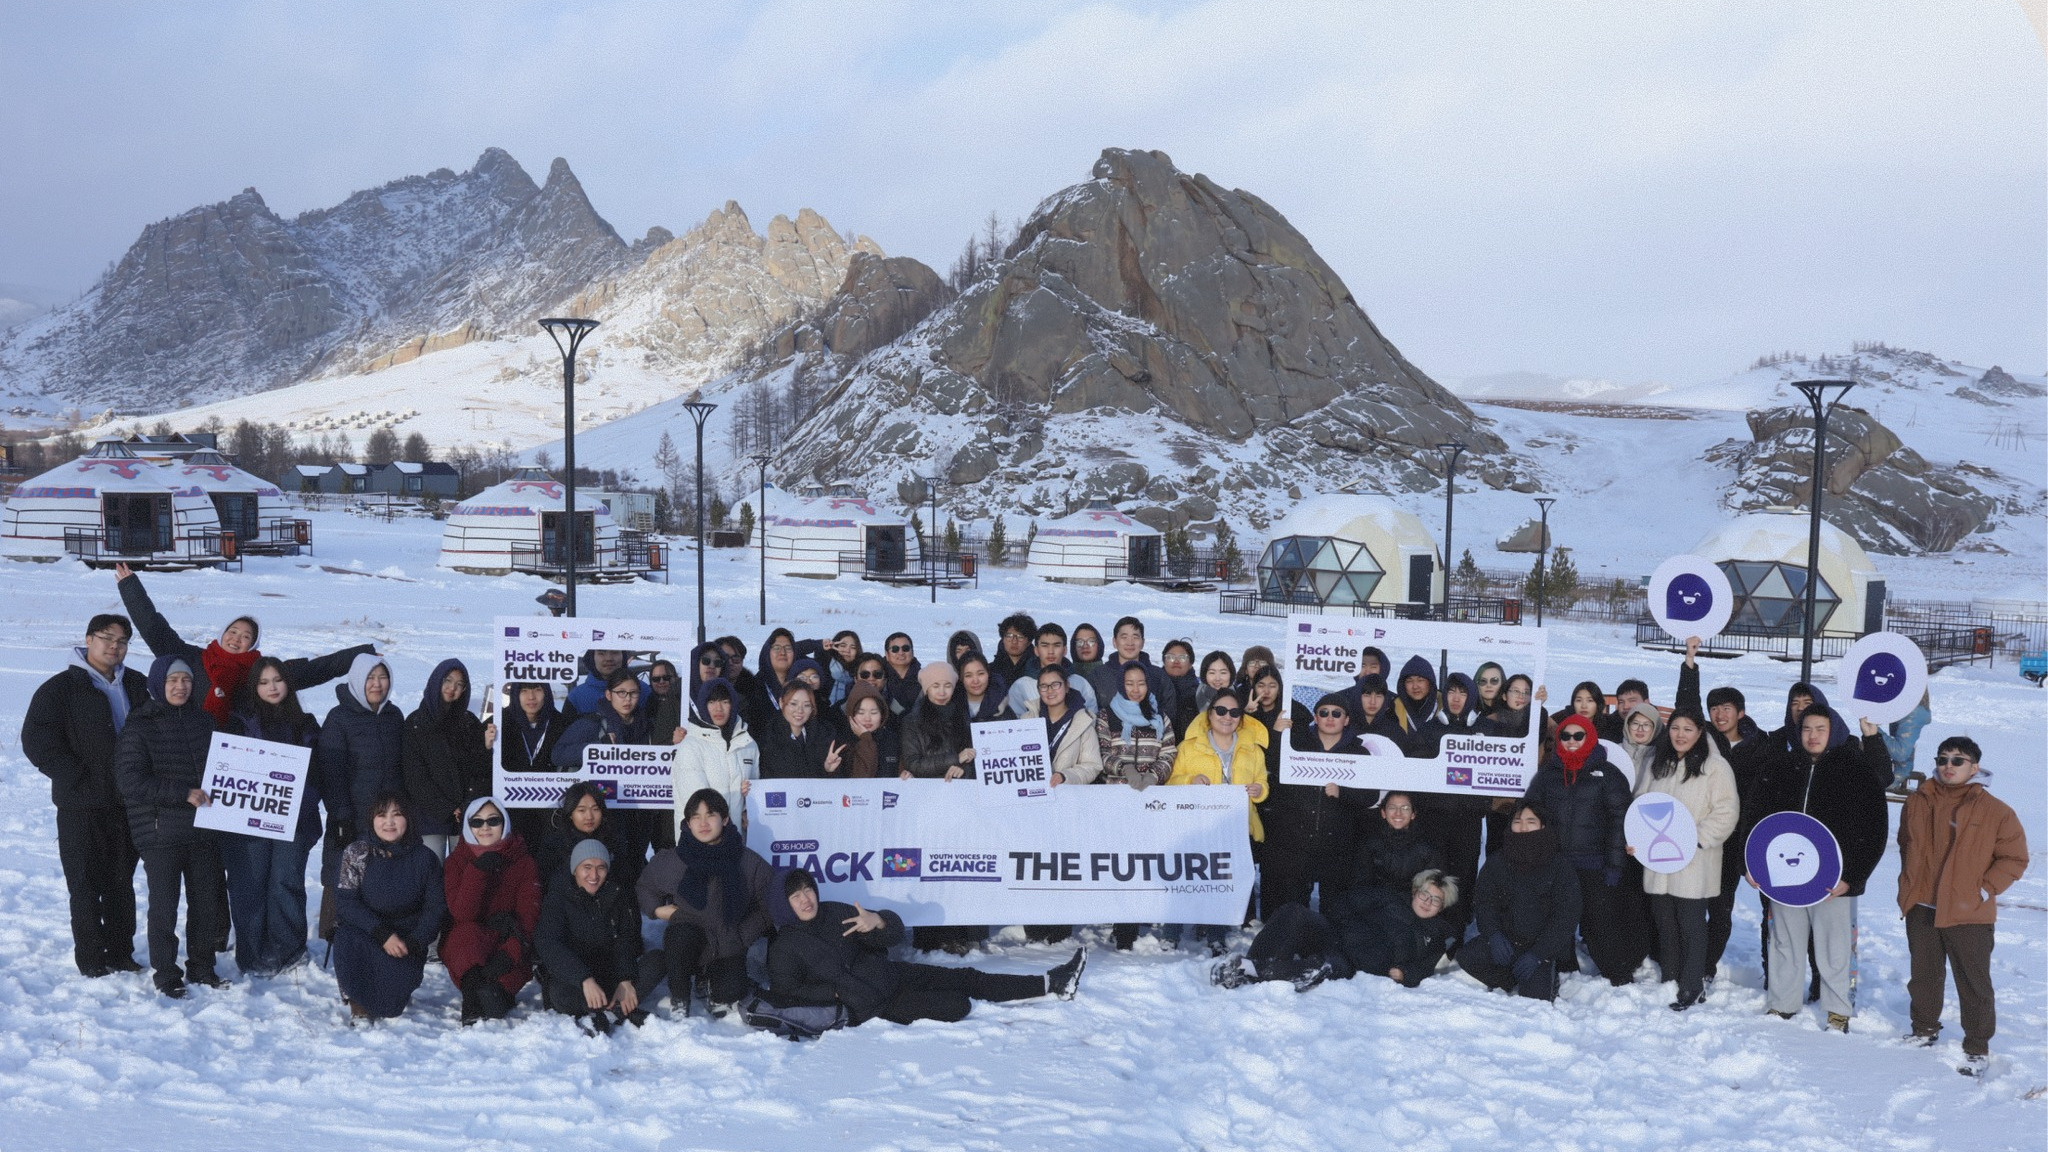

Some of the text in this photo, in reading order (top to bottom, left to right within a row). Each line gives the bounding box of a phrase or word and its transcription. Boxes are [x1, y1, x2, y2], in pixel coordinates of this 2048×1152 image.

[505, 650, 574, 663] Hack the
[1297, 644, 1358, 657] Hack the
[1296, 655, 1356, 672] future
[504, 663, 574, 680] future
[1446, 739, 1525, 754] Builders of
[588, 748, 676, 761] Builders of
[1445, 751, 1524, 767] Tomorrow.
[216, 762, 229, 772] 36
[982, 755, 1043, 770] HACK THE
[272, 772, 293, 781] HOURS
[984, 768, 1045, 786] FUTURE
[1478, 776, 1522, 786] CHANGE
[212, 774, 294, 799] HACK THE
[623, 789, 673, 797] CHANGE
[210, 789, 291, 816] FUTURE
[772, 851, 875, 883] HACK
[929, 861, 996, 873] CHANGE
[1008, 852, 1232, 882] THE FUTURE
[1171, 884, 1234, 894] HACKATHON
